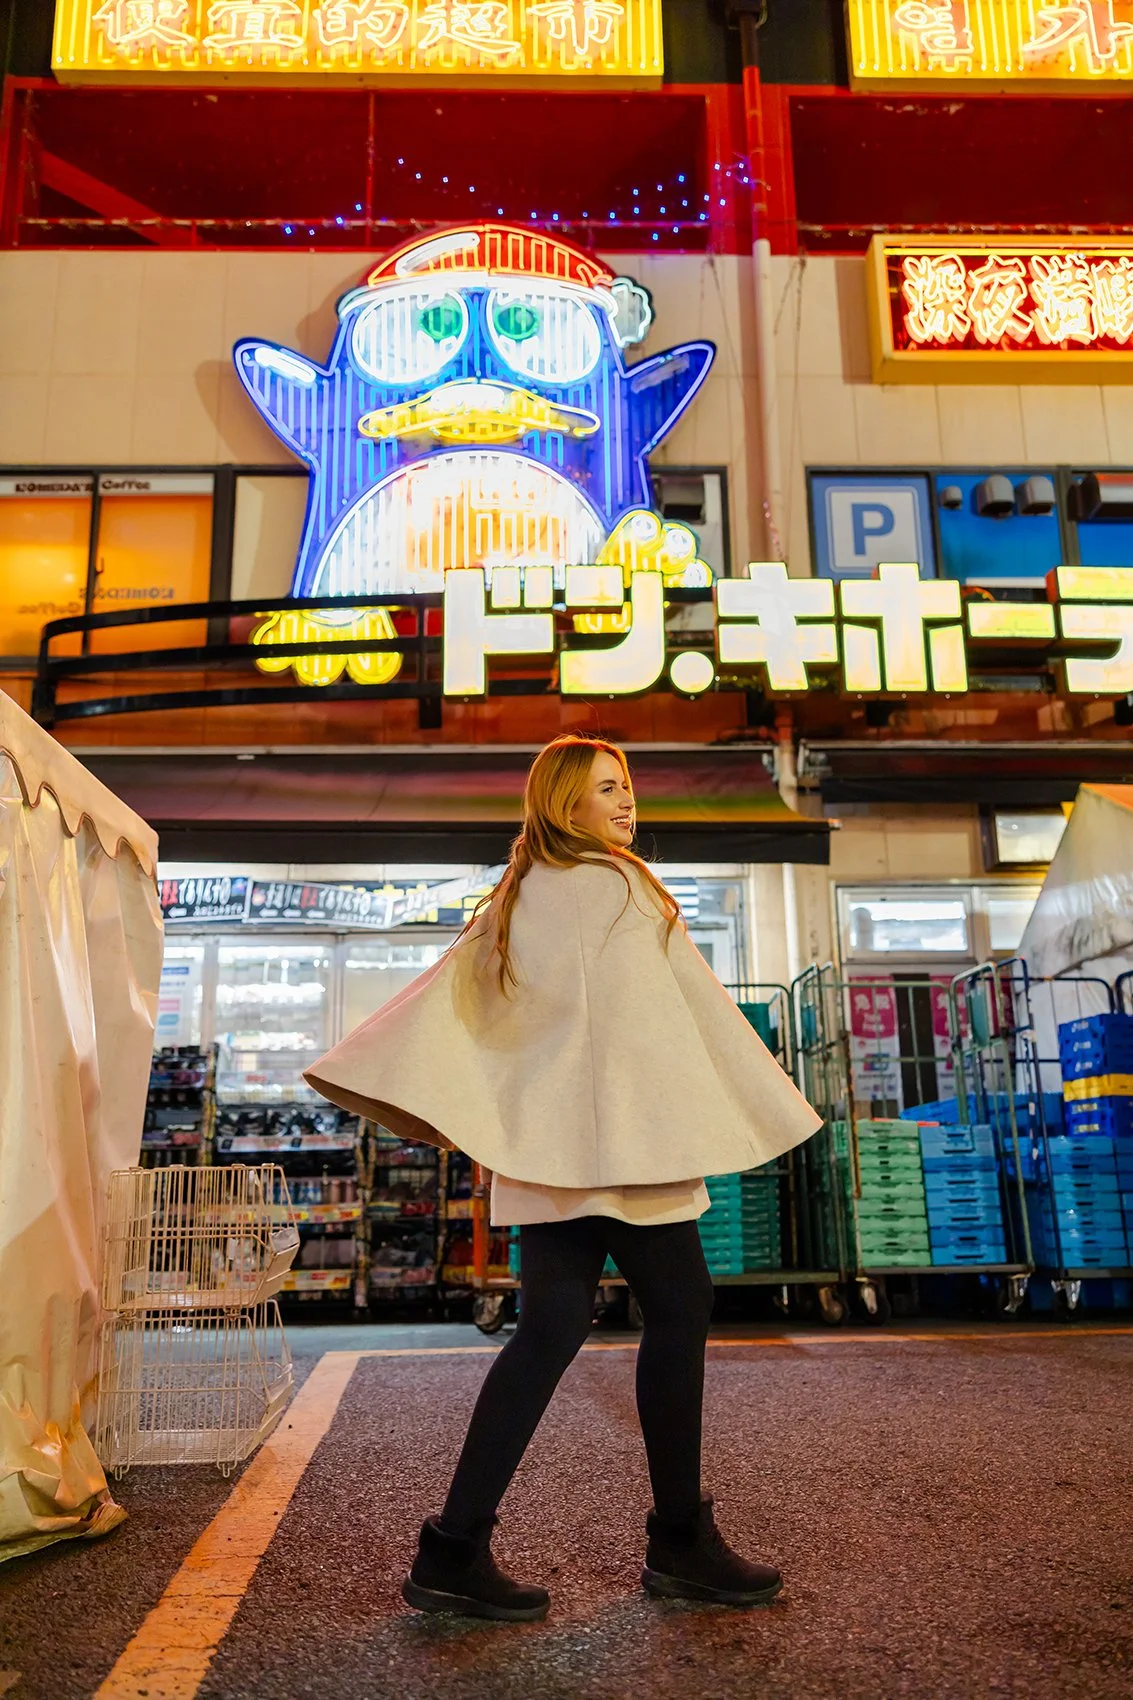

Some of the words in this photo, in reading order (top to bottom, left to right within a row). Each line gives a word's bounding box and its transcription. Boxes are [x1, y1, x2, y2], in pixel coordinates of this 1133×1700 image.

[92, 0, 624, 54] 便宜的超市
[851, 502, 895, 557] P
